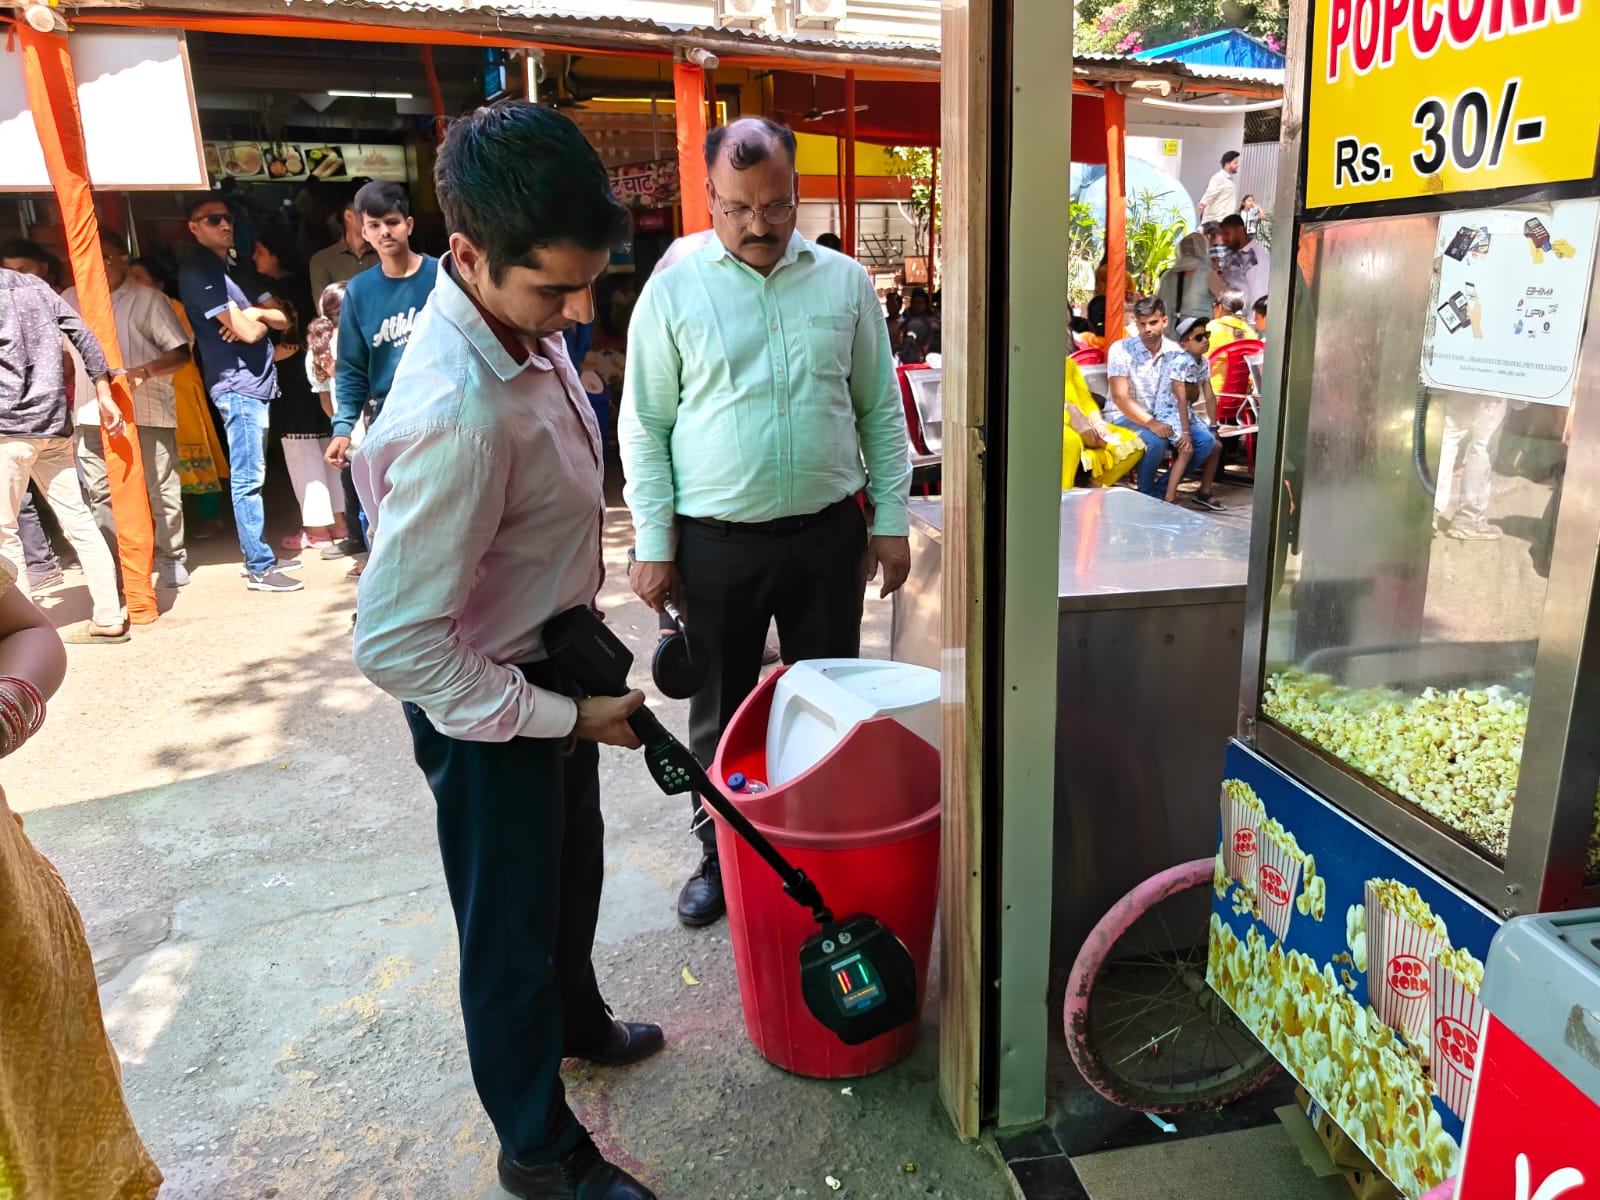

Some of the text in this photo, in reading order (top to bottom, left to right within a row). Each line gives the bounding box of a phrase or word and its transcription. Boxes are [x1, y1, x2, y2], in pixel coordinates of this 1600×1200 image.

[1334, 80, 1543, 187] Rs. 30/-
[622, 172, 655, 194] चाट
[373, 306, 416, 348] Athl
[1234, 832, 1253, 842] POP
[1235, 842, 1257, 853] CORN
[1262, 866, 1282, 887] POP
[1261, 879, 1289, 903] CORN
[1392, 959, 1423, 977] POP
[1390, 974, 1431, 993] CORN
[1441, 1020, 1479, 1055] POP
[1440, 1036, 1477, 1073] COR
